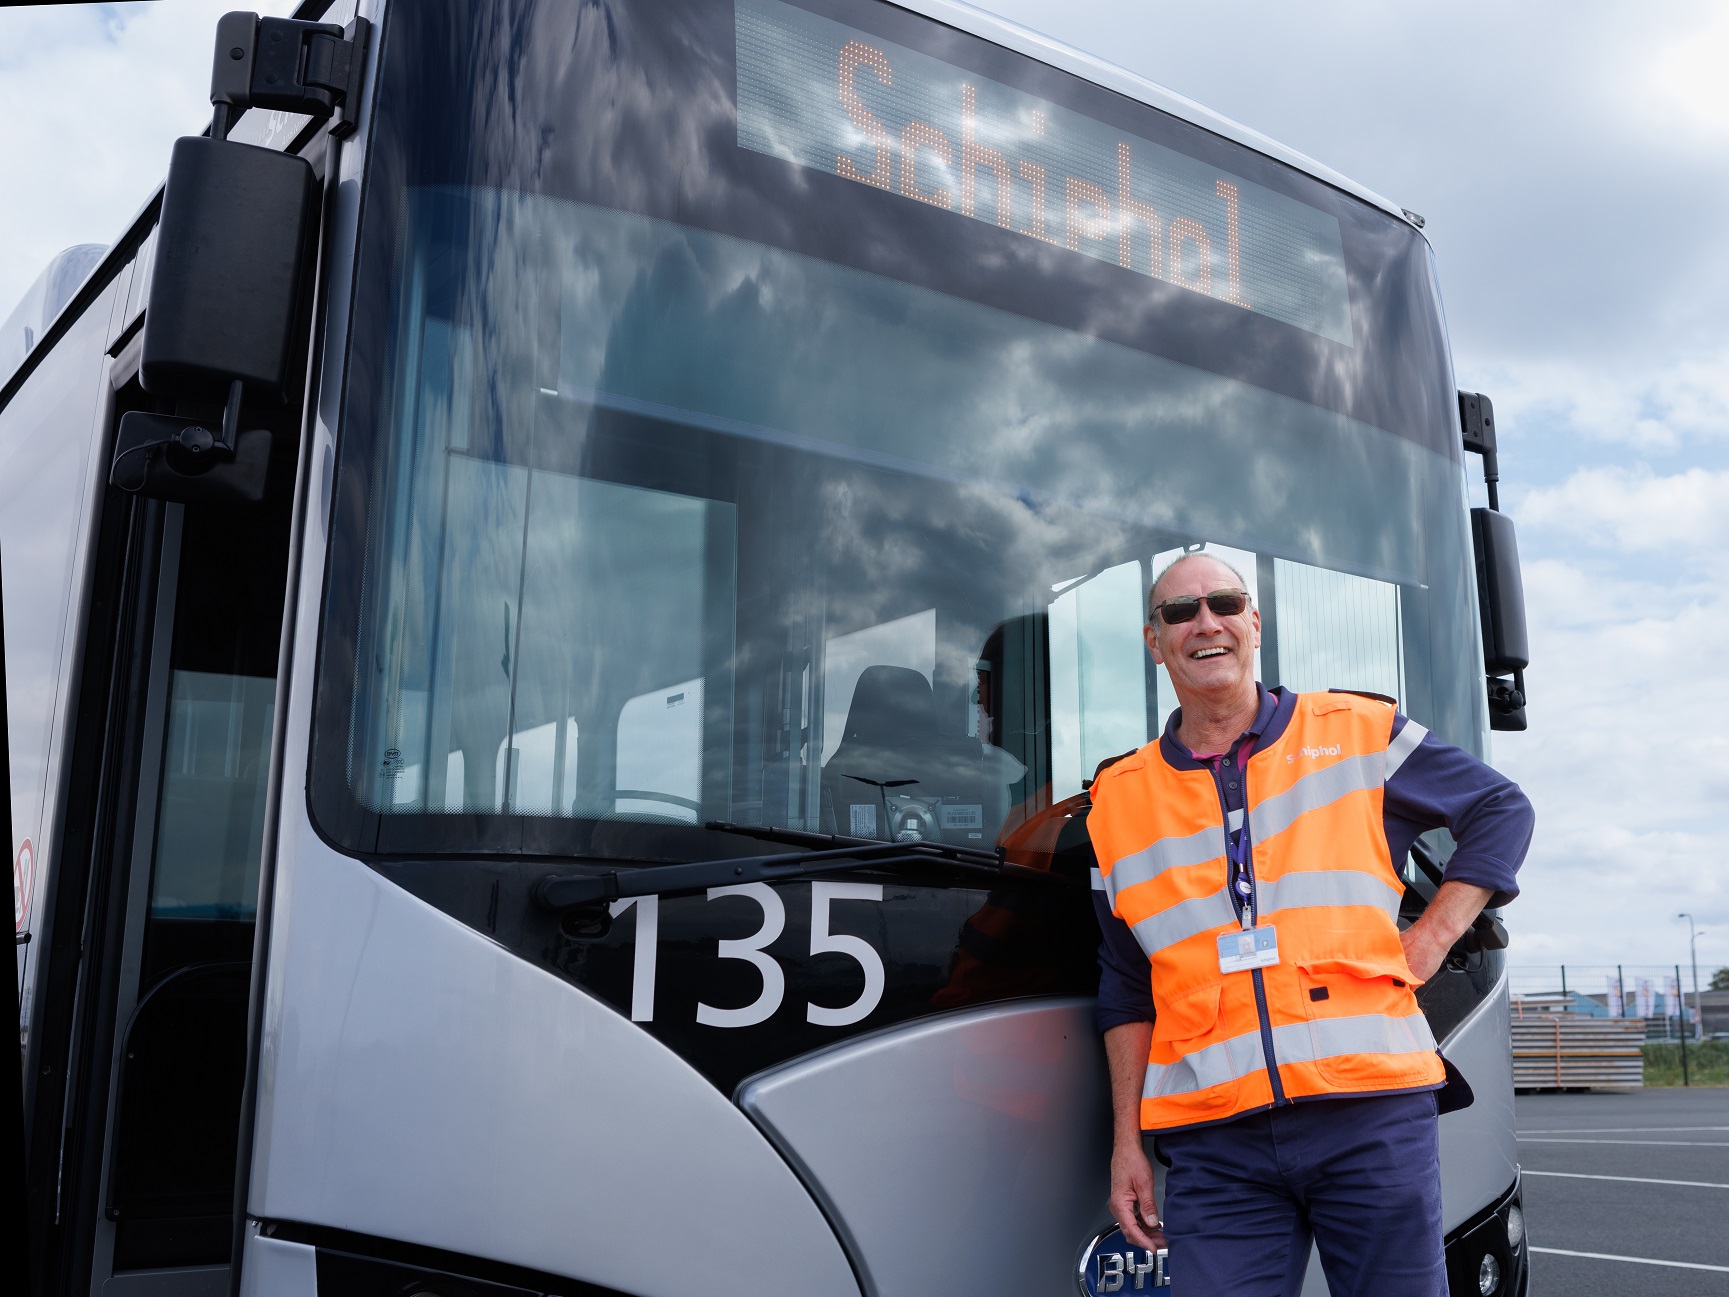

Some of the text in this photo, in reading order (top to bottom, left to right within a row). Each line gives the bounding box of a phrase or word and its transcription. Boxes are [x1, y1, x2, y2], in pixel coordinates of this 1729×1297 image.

[837, 39, 1252, 309] Schiphol
[1286, 743, 1342, 765] Shiphol
[608, 880, 885, 1028] 135
